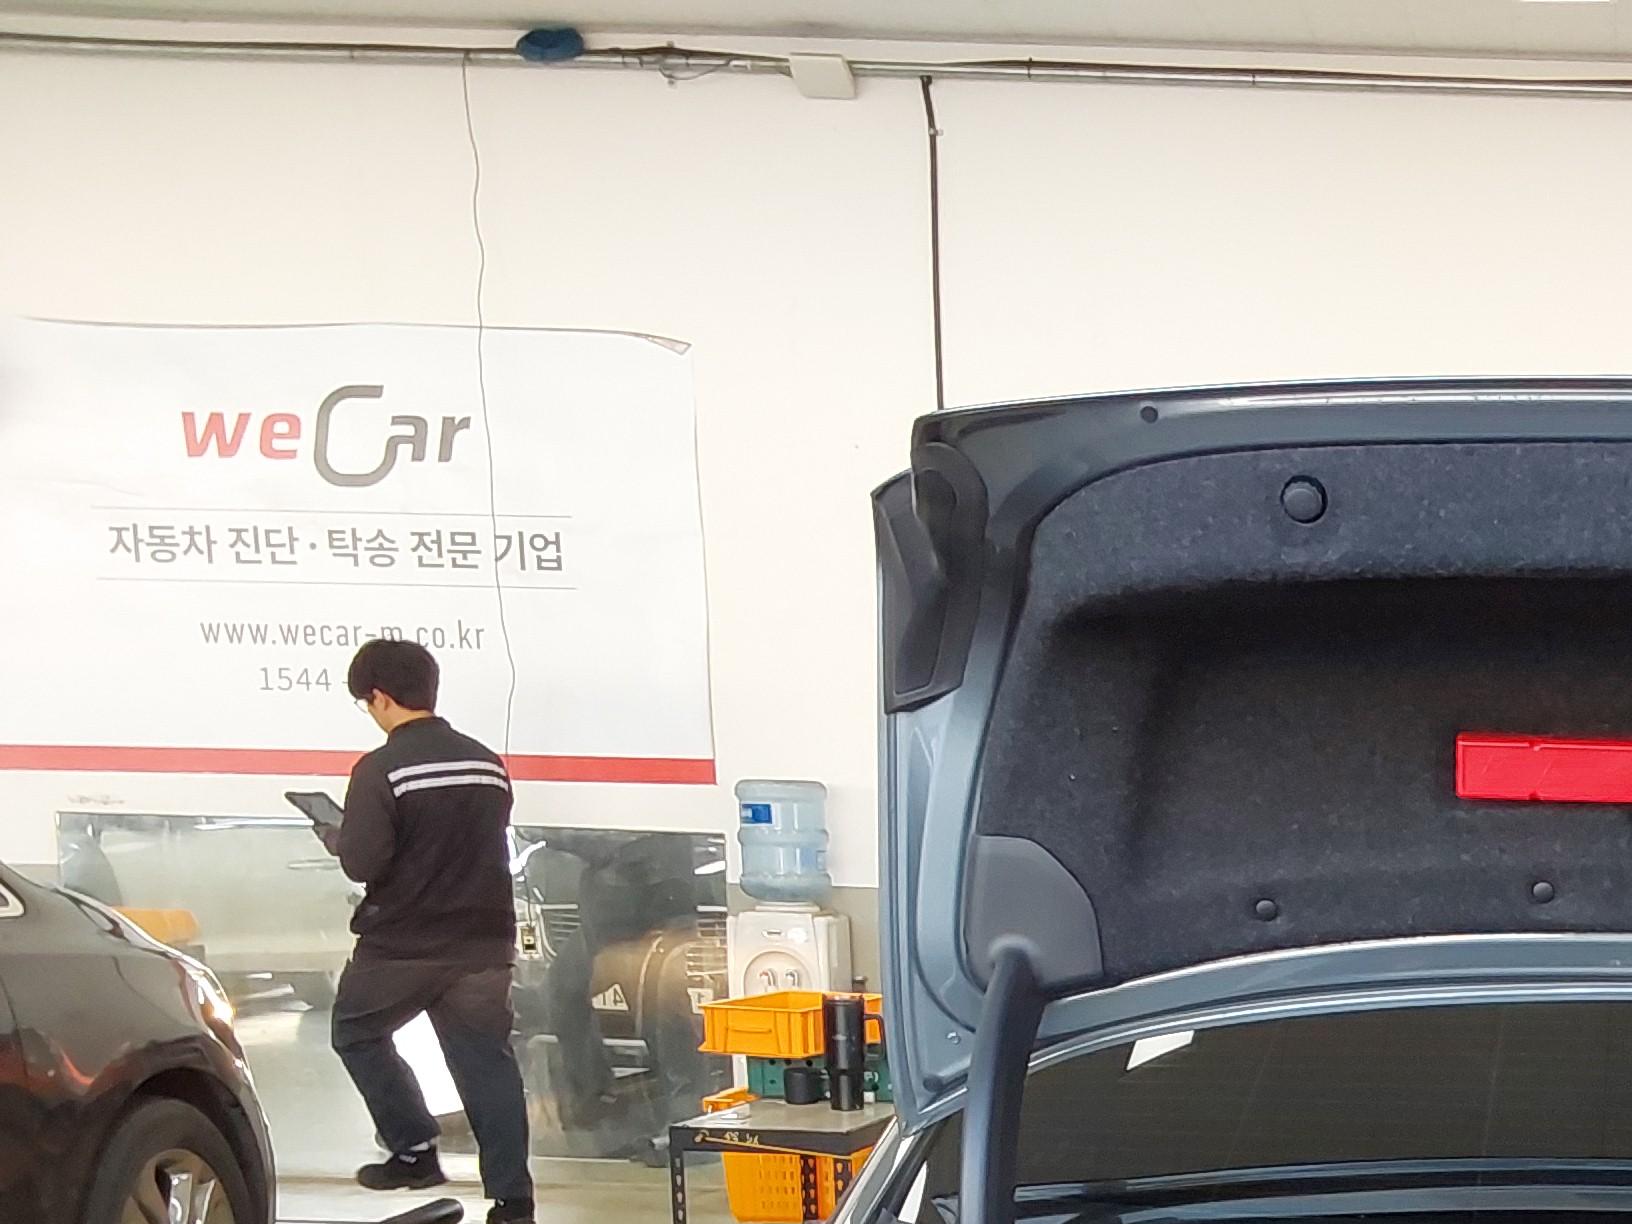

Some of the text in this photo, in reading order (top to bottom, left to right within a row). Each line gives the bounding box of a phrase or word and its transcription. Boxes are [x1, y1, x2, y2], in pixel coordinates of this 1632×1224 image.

[108, 523, 218, 563] 자동차
[409, 529, 482, 570] 전문
[494, 531, 564, 572] 기업
[200, 619, 485, 650] www.wecar-mco.kr
[259, 667, 332, 692] 1544
